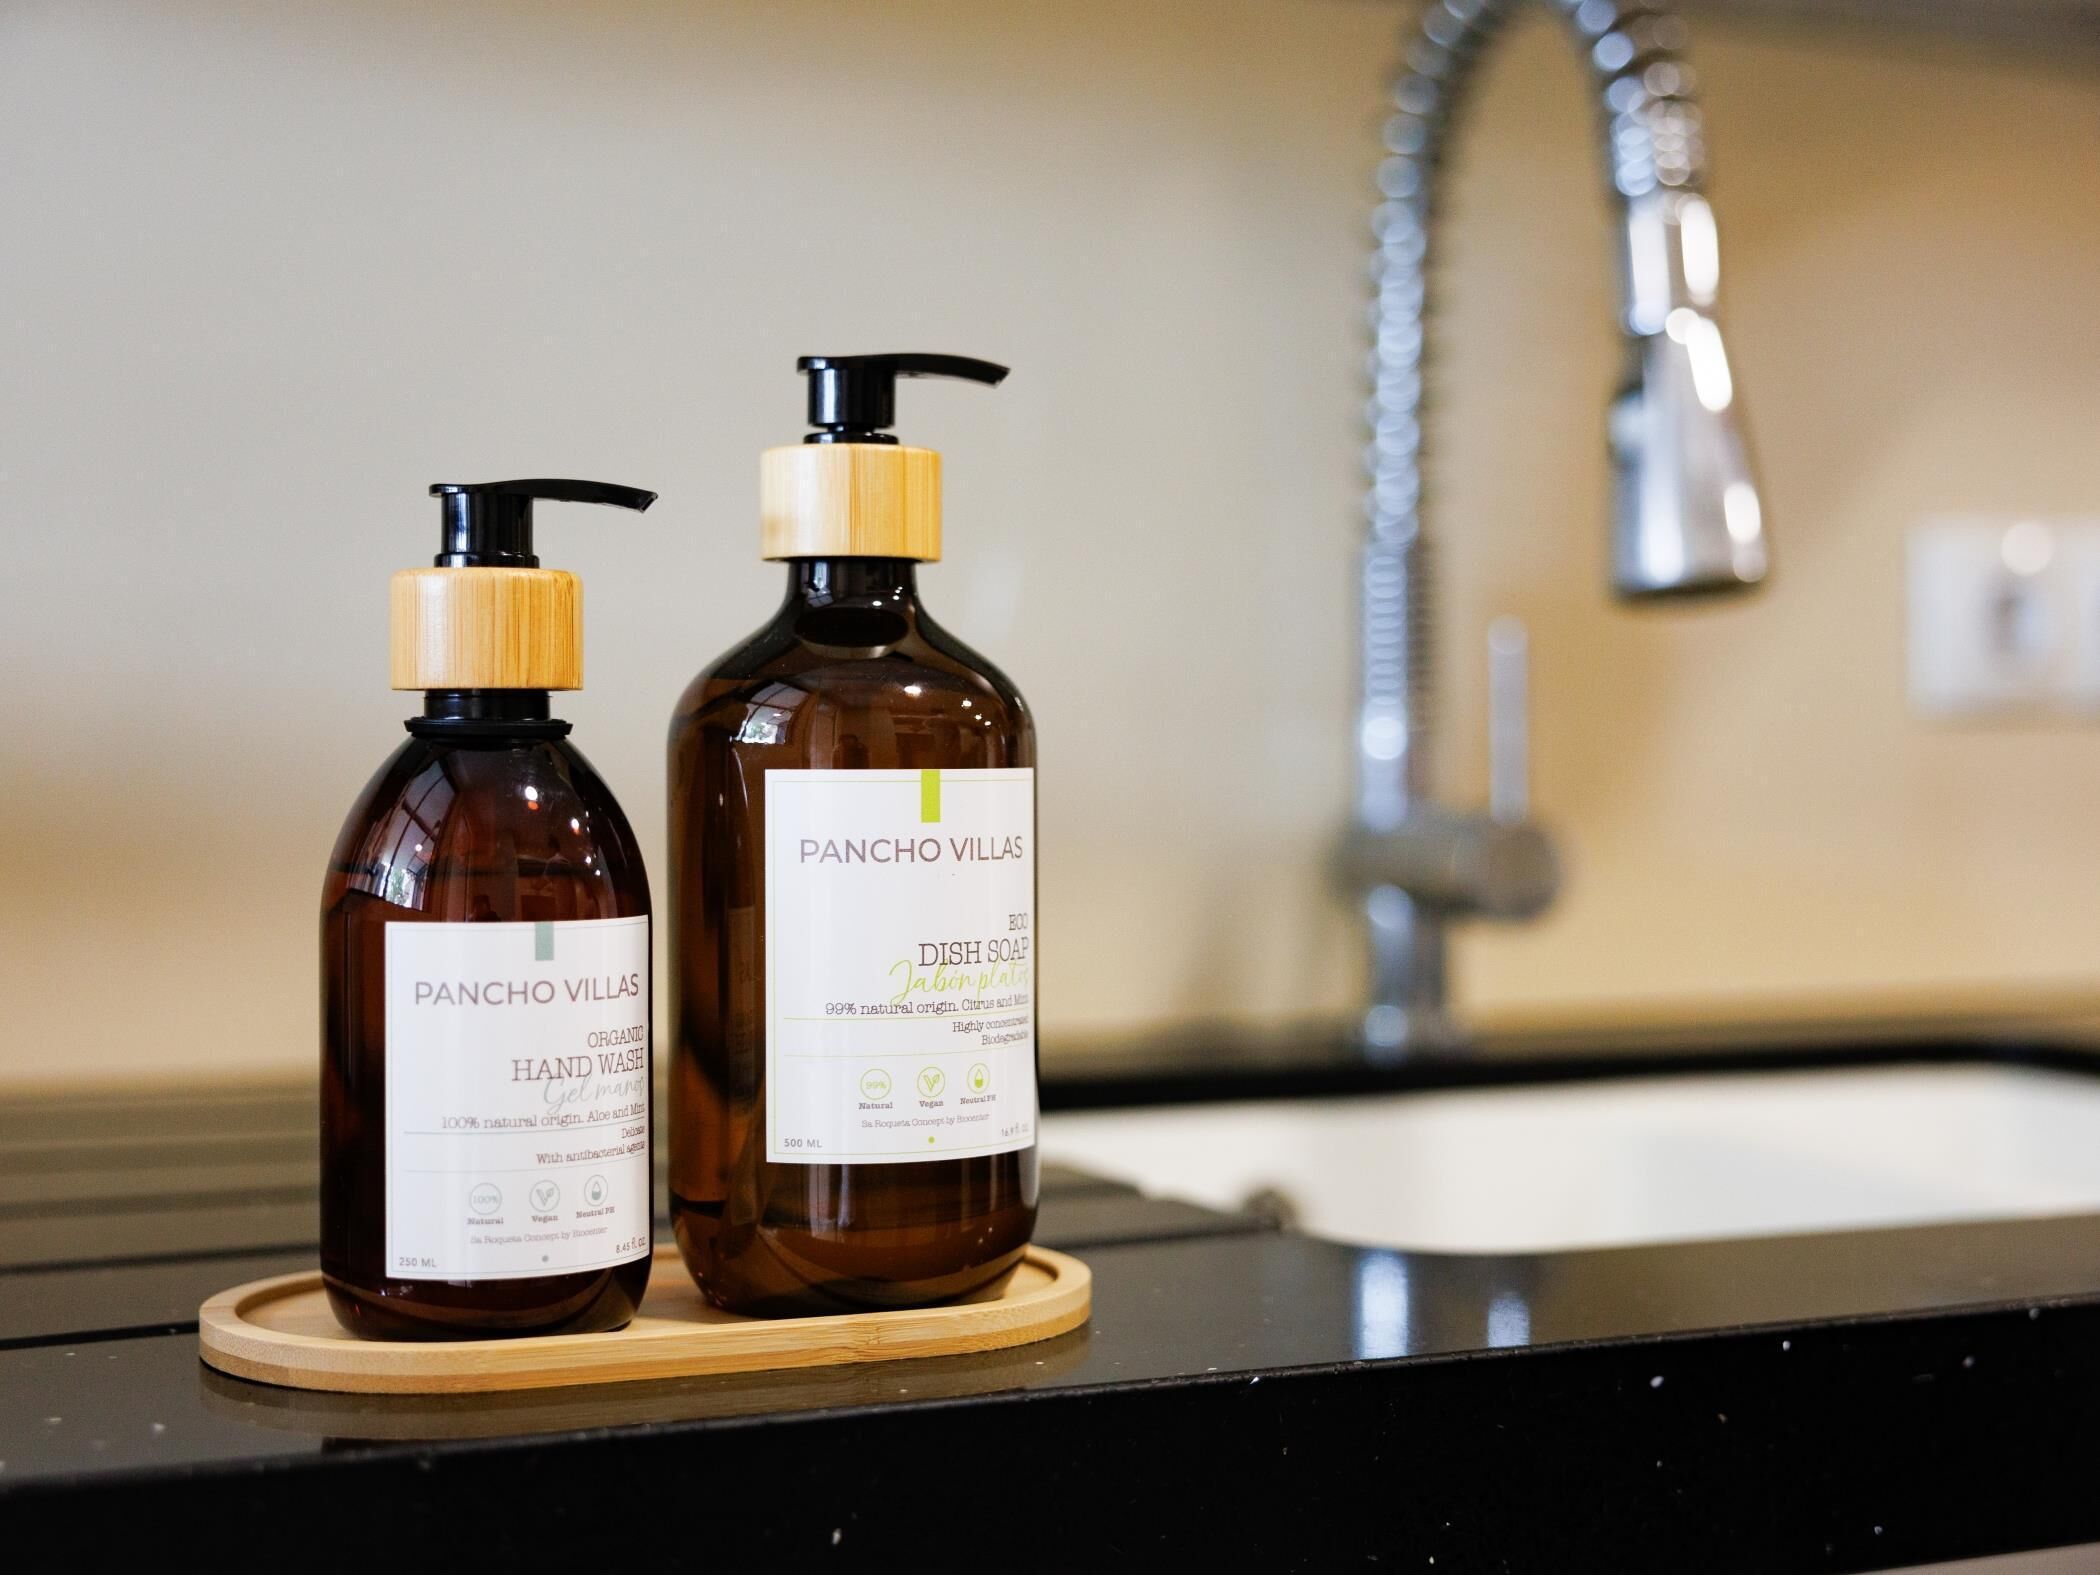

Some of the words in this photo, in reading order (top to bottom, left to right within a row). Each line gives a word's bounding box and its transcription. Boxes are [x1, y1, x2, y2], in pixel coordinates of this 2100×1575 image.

[800, 838, 941, 864] PANCHO
[949, 836, 1023, 862] VILLAS
[1008, 912, 1028, 931] ECO
[918, 940, 982, 967] DISH
[988, 936, 1029, 962] SOAP
[414, 981, 556, 1006] PANCHO
[564, 972, 639, 1002] VILLAS
[826, 1002, 857, 1015] 99%
[860, 1002, 914, 1015] natural
[916, 1000, 959, 1015] origin.
[962, 998, 995, 1011] Citrus
[996, 994, 1012, 1008] and
[588, 1025, 644, 1048] ORGANIC
[952, 1020, 984, 1034] Highly
[512, 1056, 592, 1081] HAND
[598, 1048, 644, 1075] WASH
[543, 1073, 594, 1115] Gel
[858, 1102, 893, 1110] Natural
[919, 1100, 944, 1109] Vegan
[960, 1096, 986, 1104] Neutral
[442, 1116, 480, 1130] 100%
[484, 1114, 537, 1129] natural
[541, 1112, 584, 1128] origin.
[586, 1109, 611, 1122] Aloe
[612, 1104, 629, 1120] and
[912, 1118, 944, 1127] Concept
[946, 1116, 956, 1126] by
[784, 1138, 802, 1148] 500
[806, 1138, 822, 1148] ML
[536, 1151, 563, 1164] With
[566, 1144, 625, 1162] antibacterial
[467, 1216, 504, 1225] Natural
[531, 1215, 559, 1224] Vegan
[576, 1208, 604, 1219] Neutral
[524, 1232, 560, 1243] Concept
[561, 1230, 571, 1240] by
[399, 1257, 418, 1268] 250
[421, 1258, 437, 1268] ML
